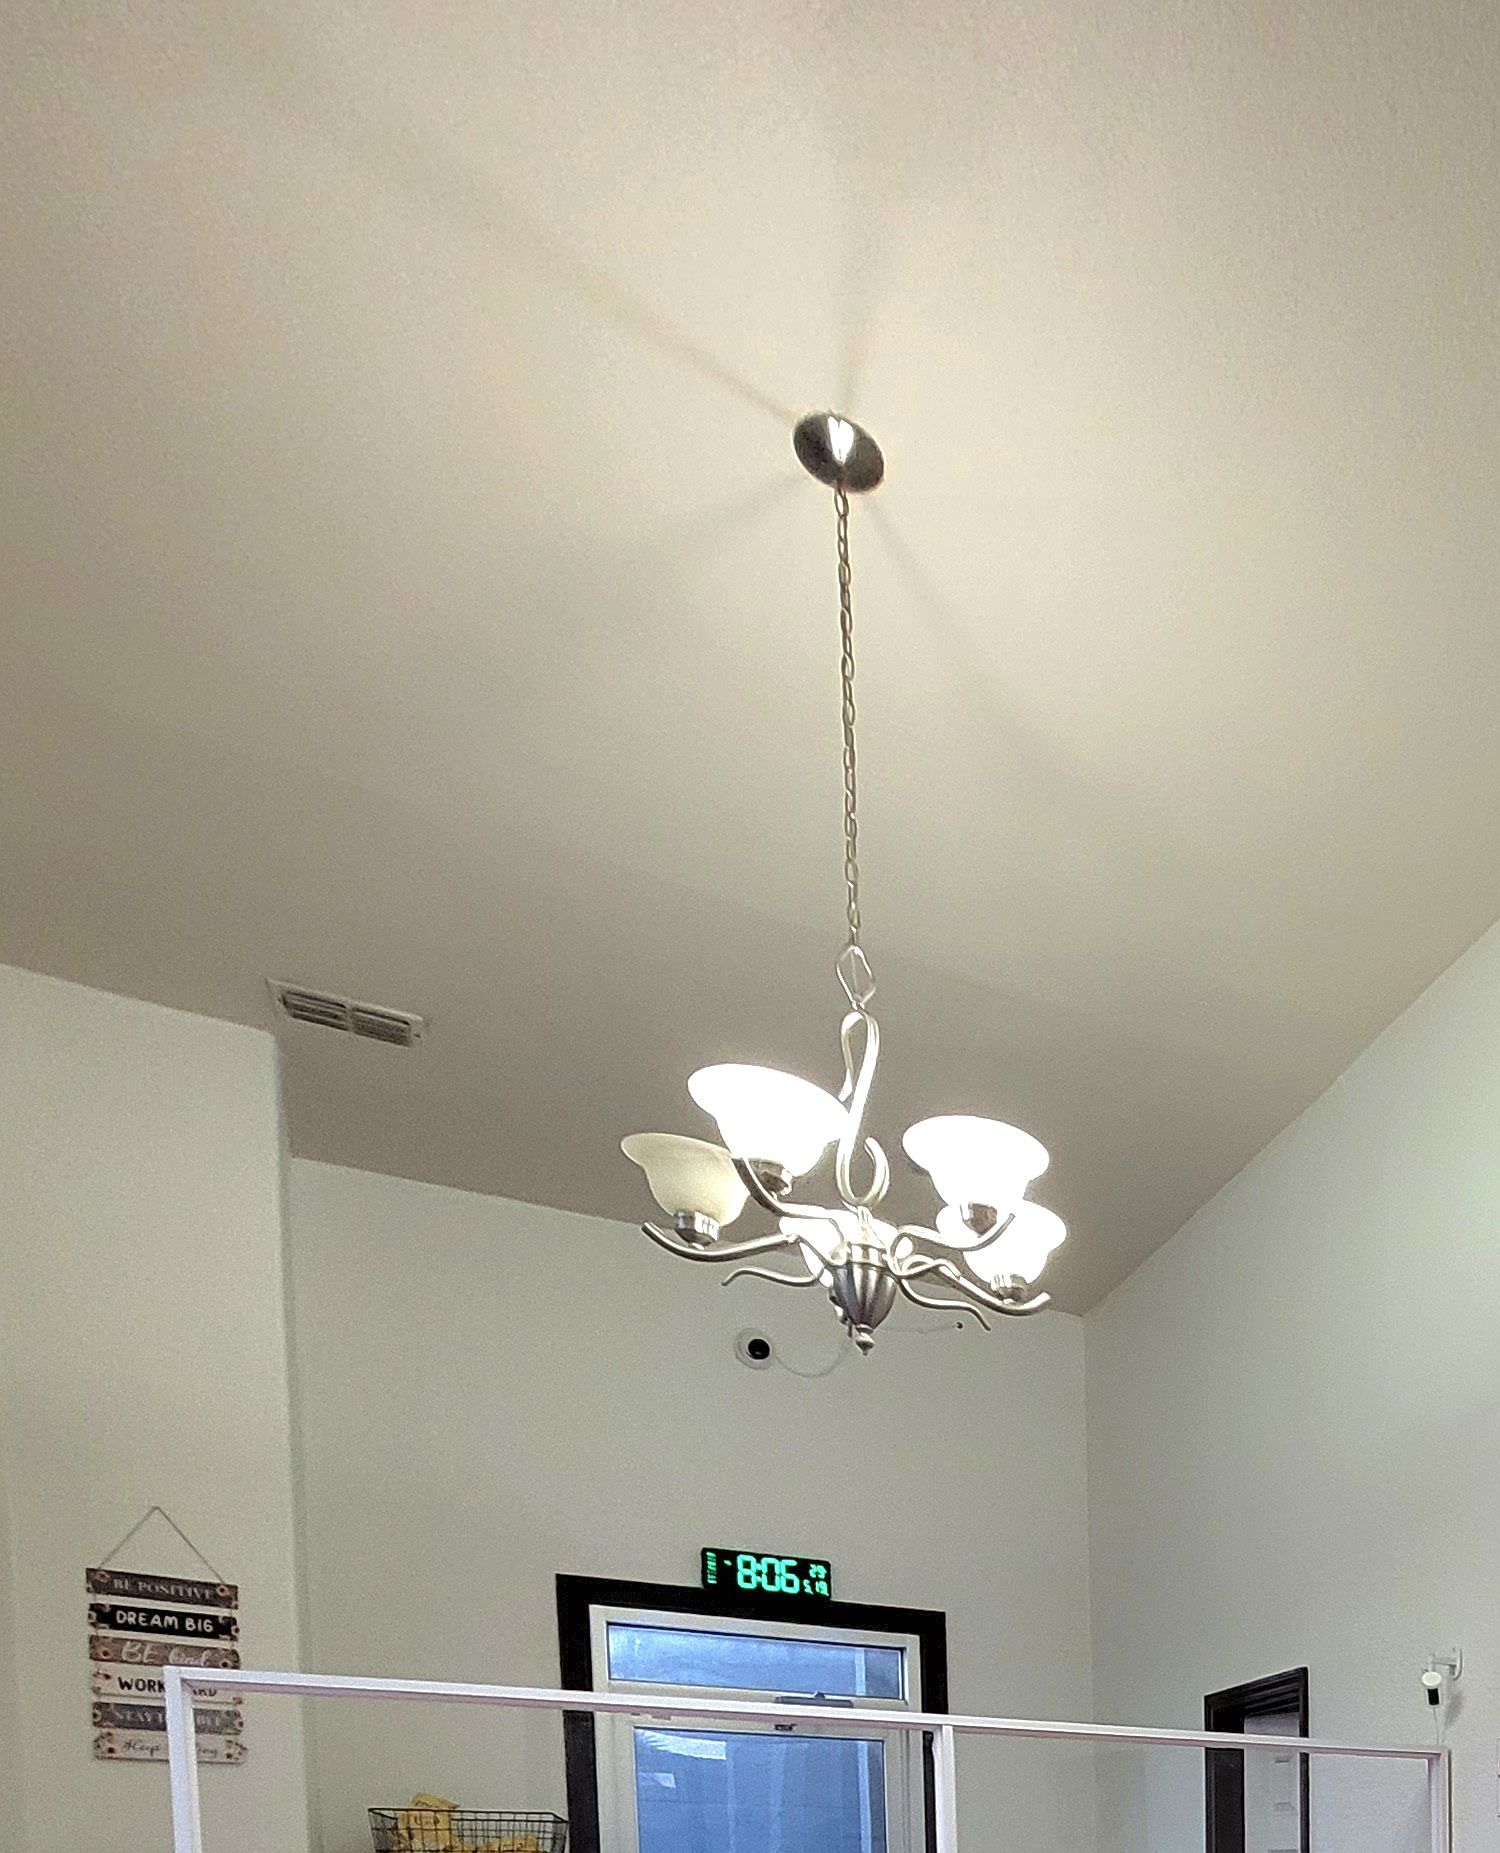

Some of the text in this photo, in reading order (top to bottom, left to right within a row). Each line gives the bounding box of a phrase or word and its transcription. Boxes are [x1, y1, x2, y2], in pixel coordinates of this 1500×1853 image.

[737, 1554, 800, 1594] 8:06
[138, 1581, 212, 1599] POSITIVE
[116, 1610, 214, 1633] DREAM BIG
[122, 1640, 156, 1664] BE
[117, 1676, 166, 1693] WORK
